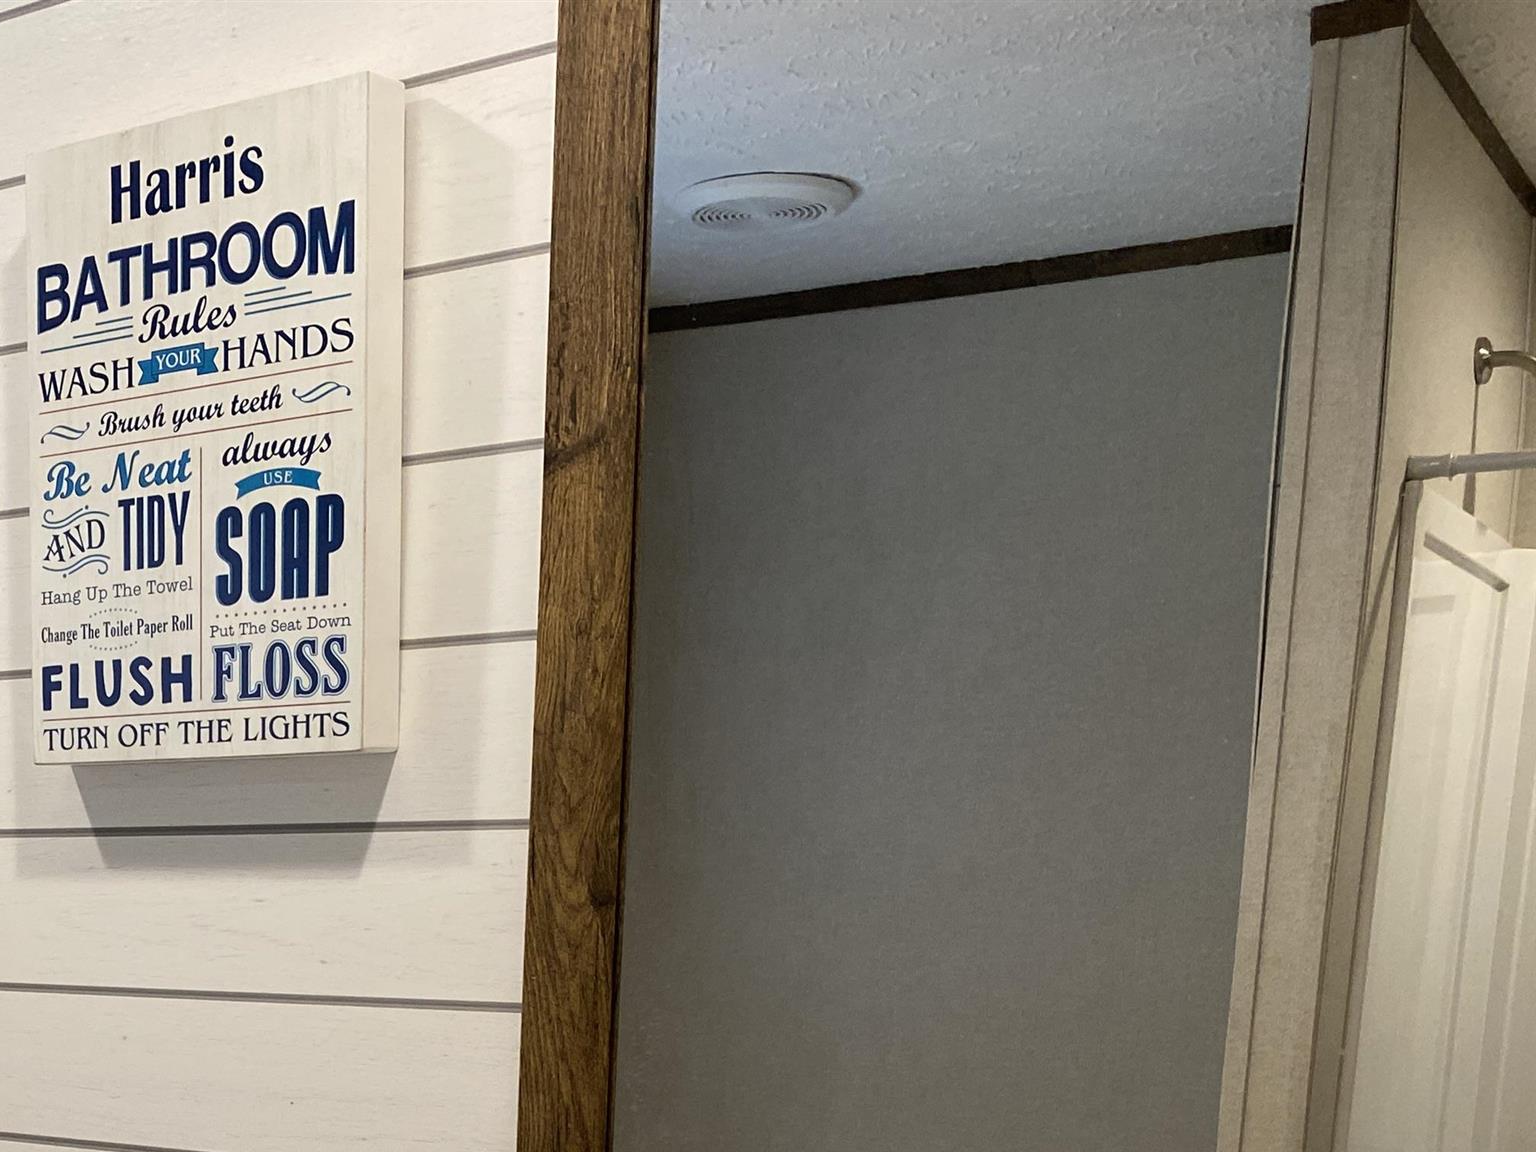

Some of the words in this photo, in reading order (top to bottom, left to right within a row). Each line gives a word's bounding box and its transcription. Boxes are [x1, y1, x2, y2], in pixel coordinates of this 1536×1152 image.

[110, 135, 264, 224] Harris
[37, 199, 355, 335] BATHROOM
[138, 296, 237, 344] Rules
[38, 357, 134, 402] WASH
[155, 345, 202, 370] YOUR
[222, 318, 354, 371] HANDS
[98, 404, 166, 437] Brush
[172, 398, 224, 431] your
[231, 384, 283, 412] teeth
[43, 461, 92, 501] Be
[101, 448, 193, 494] Neat
[222, 431, 332, 468] always
[263, 470, 293, 484] USE
[42, 518, 105, 563] AND
[118, 491, 191, 571] TIDY
[215, 493, 345, 607] SOAP
[41, 590, 81, 606] Hang
[86, 586, 108, 603] Up
[113, 583, 141, 598] The
[146, 576, 193, 595] Towel
[41, 627, 78, 645] Change
[80, 623, 100, 640] The
[103, 620, 133, 638] Toilet
[137, 618, 168, 638] Paper
[171, 613, 193, 632] Roll
[209, 624, 235, 639] Put
[239, 621, 265, 636] The
[270, 617, 302, 633] Seat
[306, 614, 351, 630] Down
[42, 654, 192, 711] FLUSH
[210, 634, 350, 703] FLOSS
[43, 725, 109, 751] TURN
[118, 722, 169, 747] OFF
[178, 719, 232, 744] THE
[243, 711, 351, 742] LIGHTS
